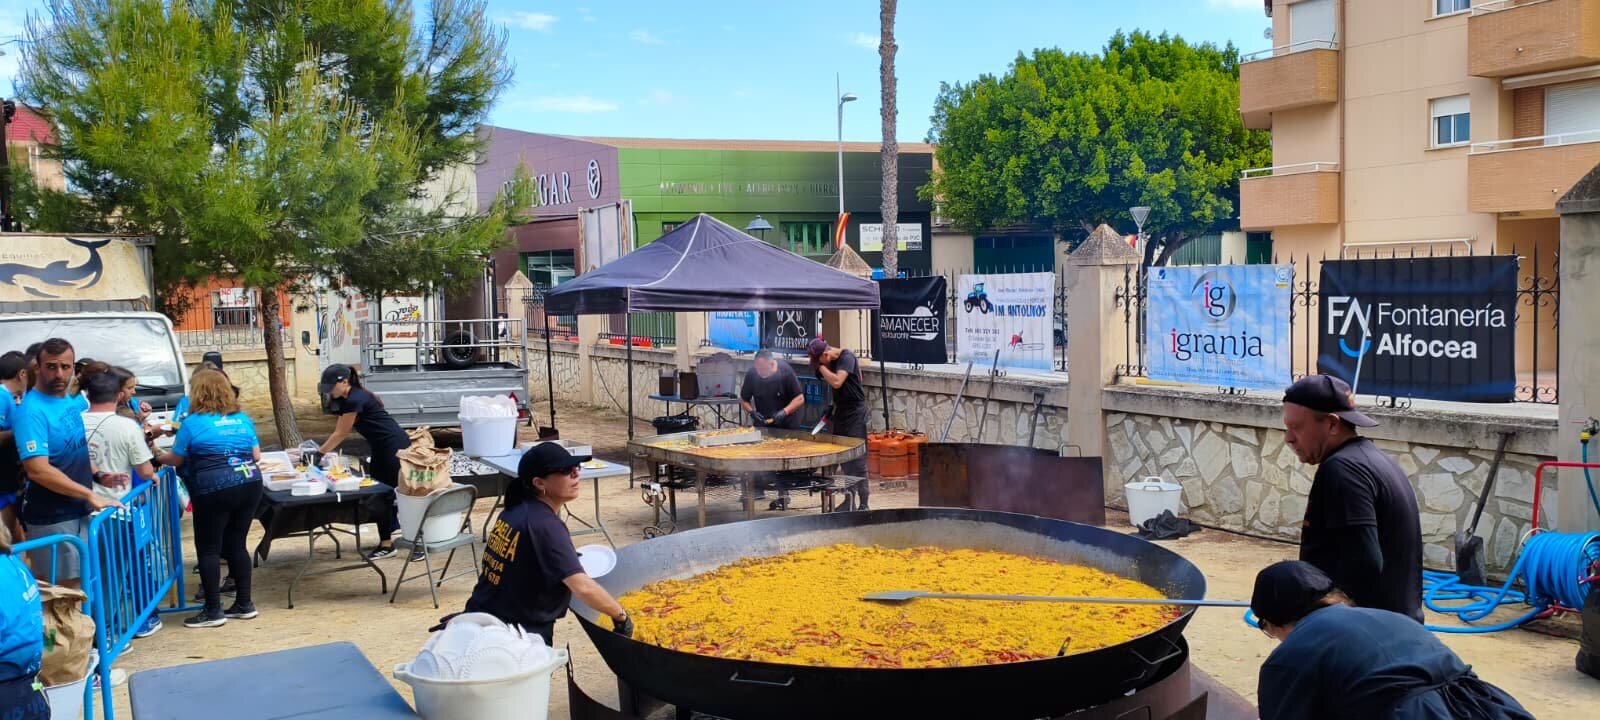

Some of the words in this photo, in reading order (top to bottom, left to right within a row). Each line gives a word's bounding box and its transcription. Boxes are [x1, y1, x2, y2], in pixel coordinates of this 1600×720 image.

[880, 317, 940, 332] AMANECER
[1378, 302, 1507, 328] Fontanería
[1170, 328, 1264, 361] igranja
[1376, 332, 1478, 359] Alfocea
